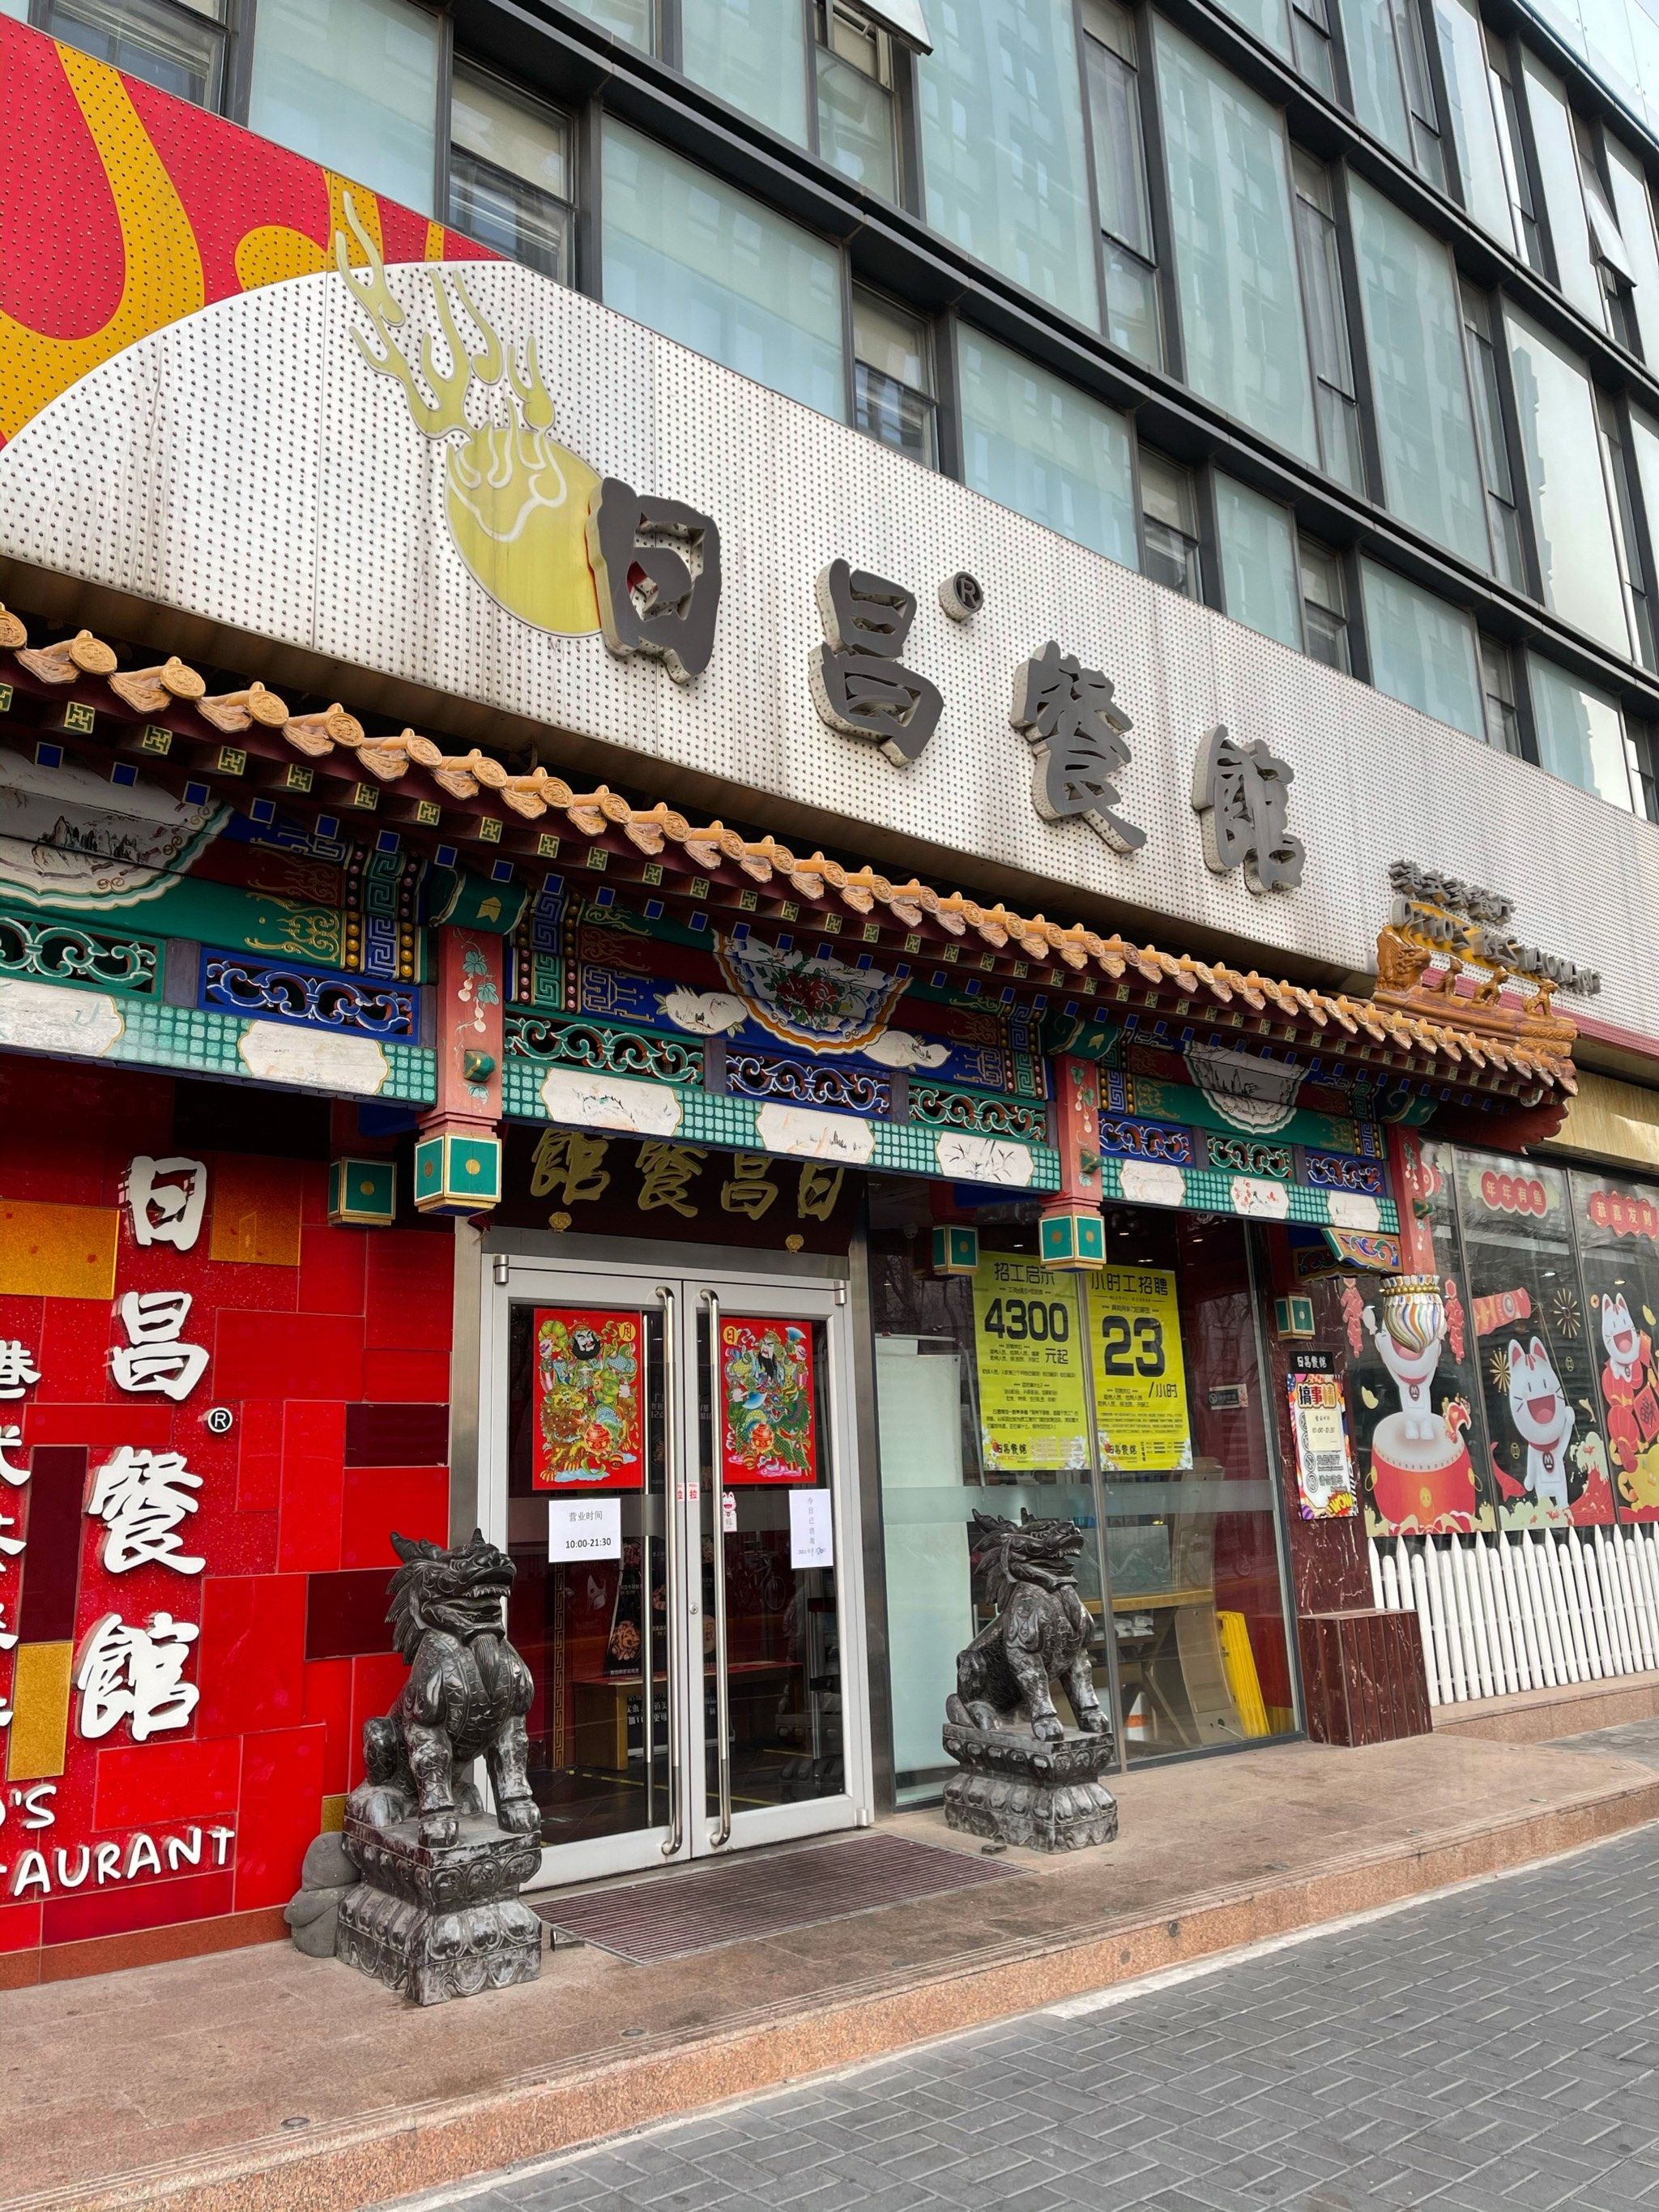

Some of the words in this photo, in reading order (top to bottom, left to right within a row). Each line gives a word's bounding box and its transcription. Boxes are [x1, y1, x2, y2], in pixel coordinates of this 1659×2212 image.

[1486, 1181, 1543, 1206] 年年有鱼
[994, 1262, 1056, 1286] 招工启示
[1091, 1270, 1168, 1296] 小时工招聘
[984, 1297, 1069, 1343] 4300
[1045, 1347, 1069, 1364] 元起
[1102, 1315, 1166, 1377] 23
[1149, 1381, 1178, 1398] /小时
[1299, 1386, 1335, 1405] 搞事情
[569, 1510, 603, 1522] 营业时间
[565, 1537, 612, 1549] 10:00-21:30
[0, 1826, 236, 1898] AURANT
